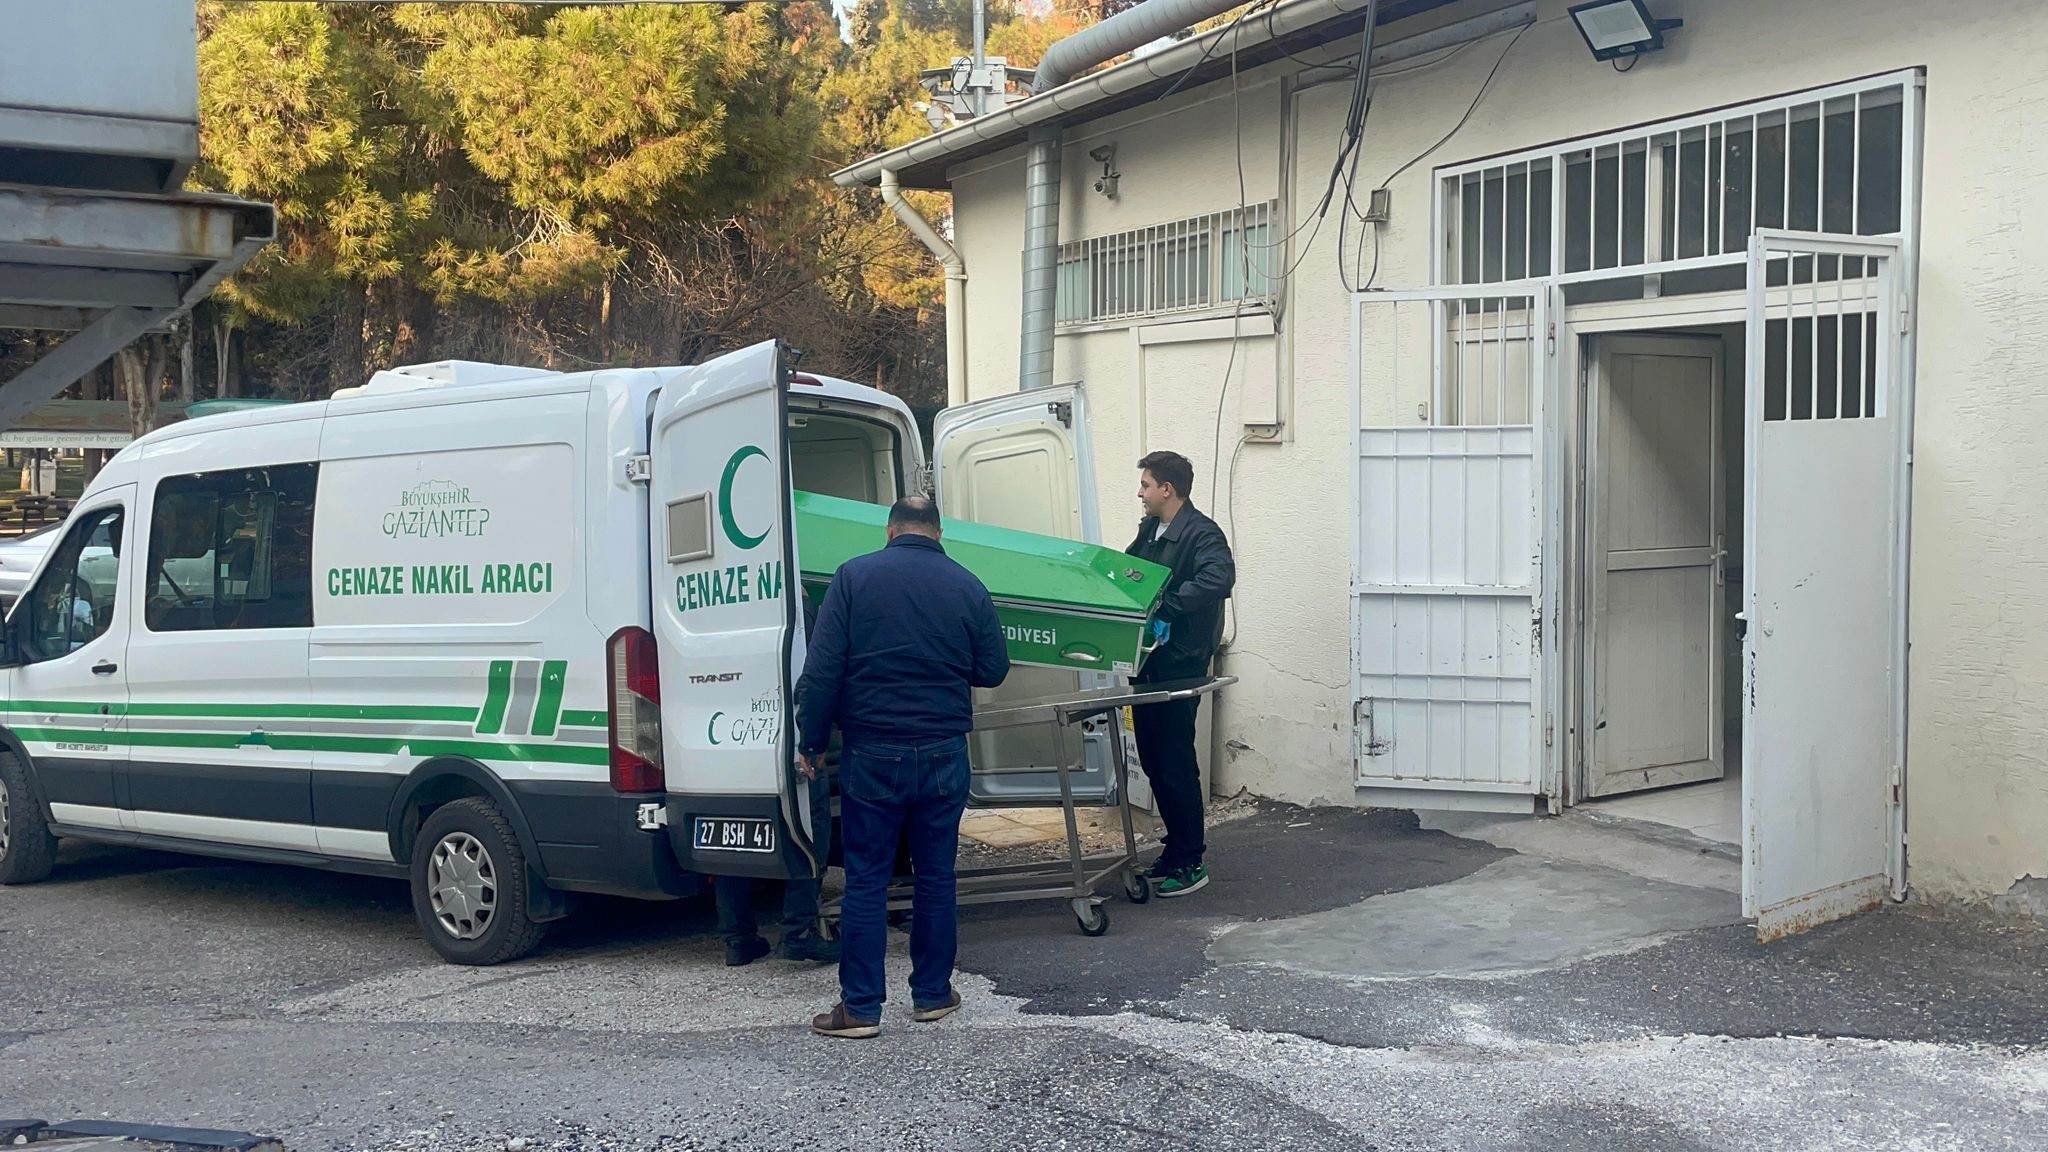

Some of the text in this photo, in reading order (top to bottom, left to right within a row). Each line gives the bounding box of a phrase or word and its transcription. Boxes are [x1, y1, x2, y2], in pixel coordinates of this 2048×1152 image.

[382, 507, 490, 539] GAZİANTEP
[328, 566, 404, 596] CENAZE
[481, 562, 552, 594] ARACI
[676, 565, 750, 612] CENAZE
[688, 672, 743, 684] TRANSIT
[701, 822, 769, 847] 27 BSH 41
